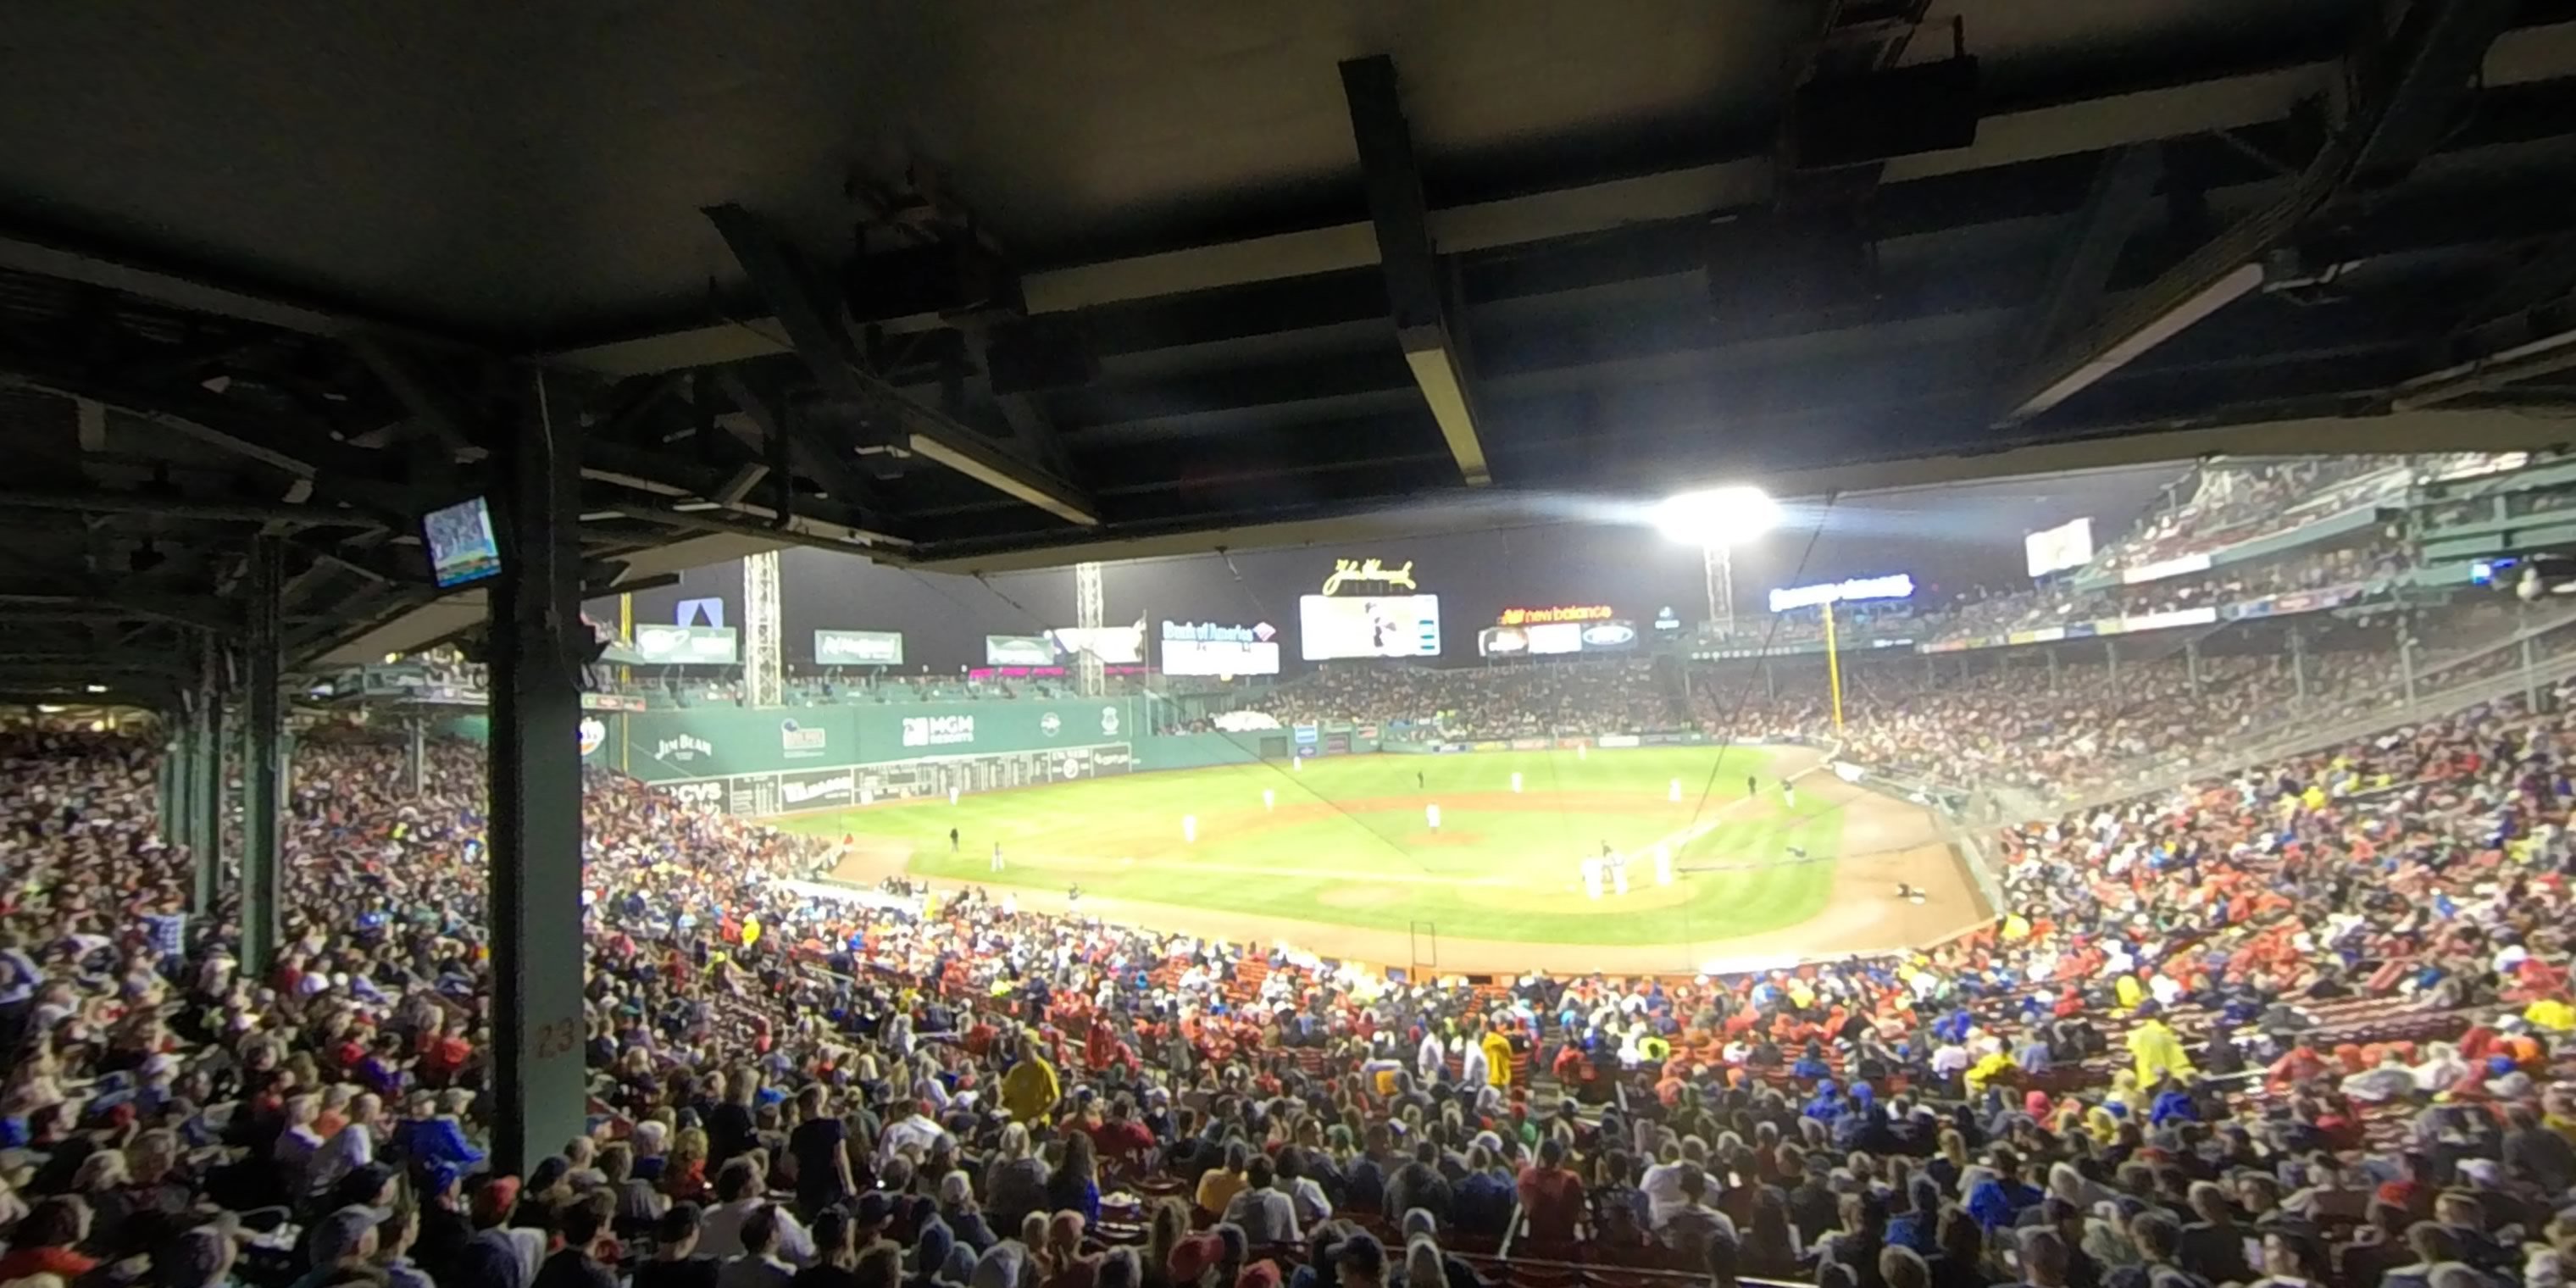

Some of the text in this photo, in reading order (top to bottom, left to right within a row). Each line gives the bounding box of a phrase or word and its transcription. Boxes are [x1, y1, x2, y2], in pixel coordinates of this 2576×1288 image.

[1525, 610, 1553, 623] new
[1553, 605, 1612, 621] balance
[1162, 620, 1253, 642] Bank of America
[930, 715, 974, 734] MGM
[679, 734, 712, 757] BEAM
[678, 781, 722, 804] CVS
[536, 1017, 575, 1058] 23
